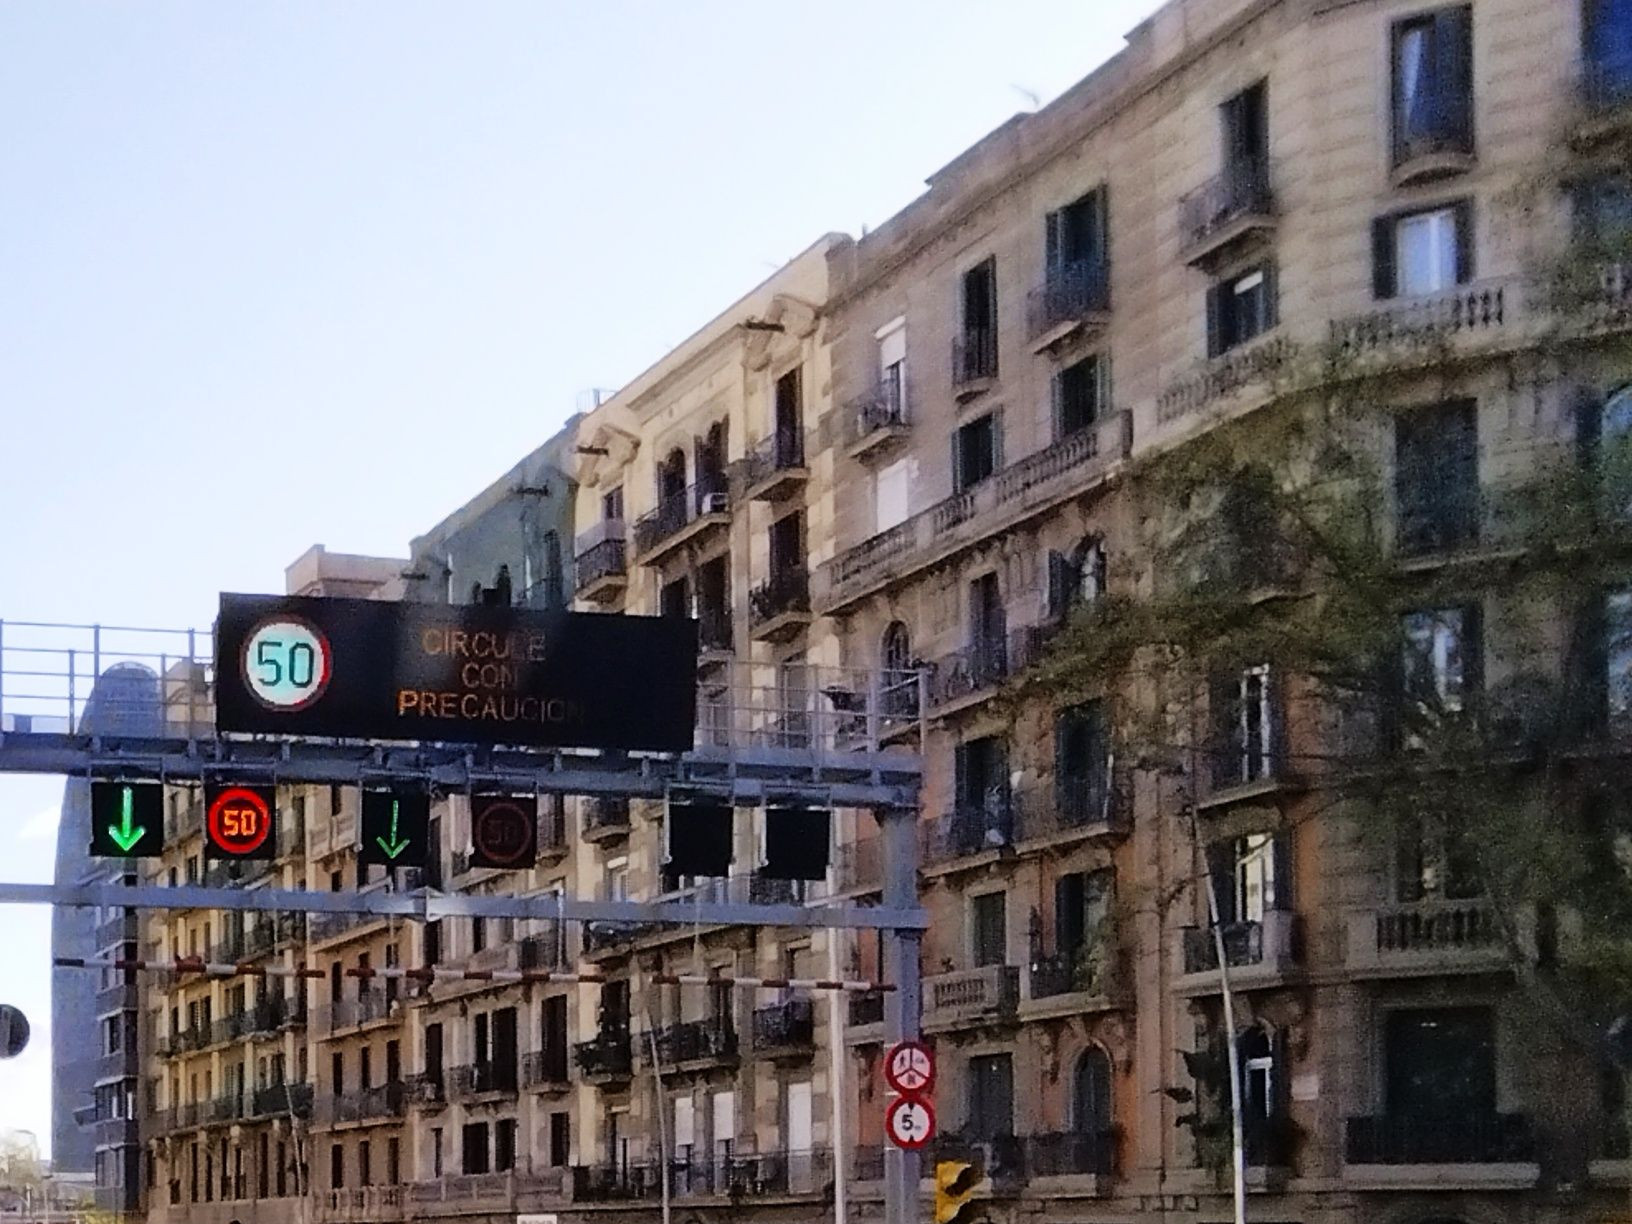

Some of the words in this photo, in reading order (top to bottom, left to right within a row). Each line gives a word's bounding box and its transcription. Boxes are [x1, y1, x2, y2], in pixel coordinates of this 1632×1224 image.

[257, 640, 315, 688] 50
[461, 661, 518, 688] CON
[397, 690, 584, 724] PRECAUCIO
[224, 809, 257, 836] 50
[901, 1114, 914, 1131] 5
